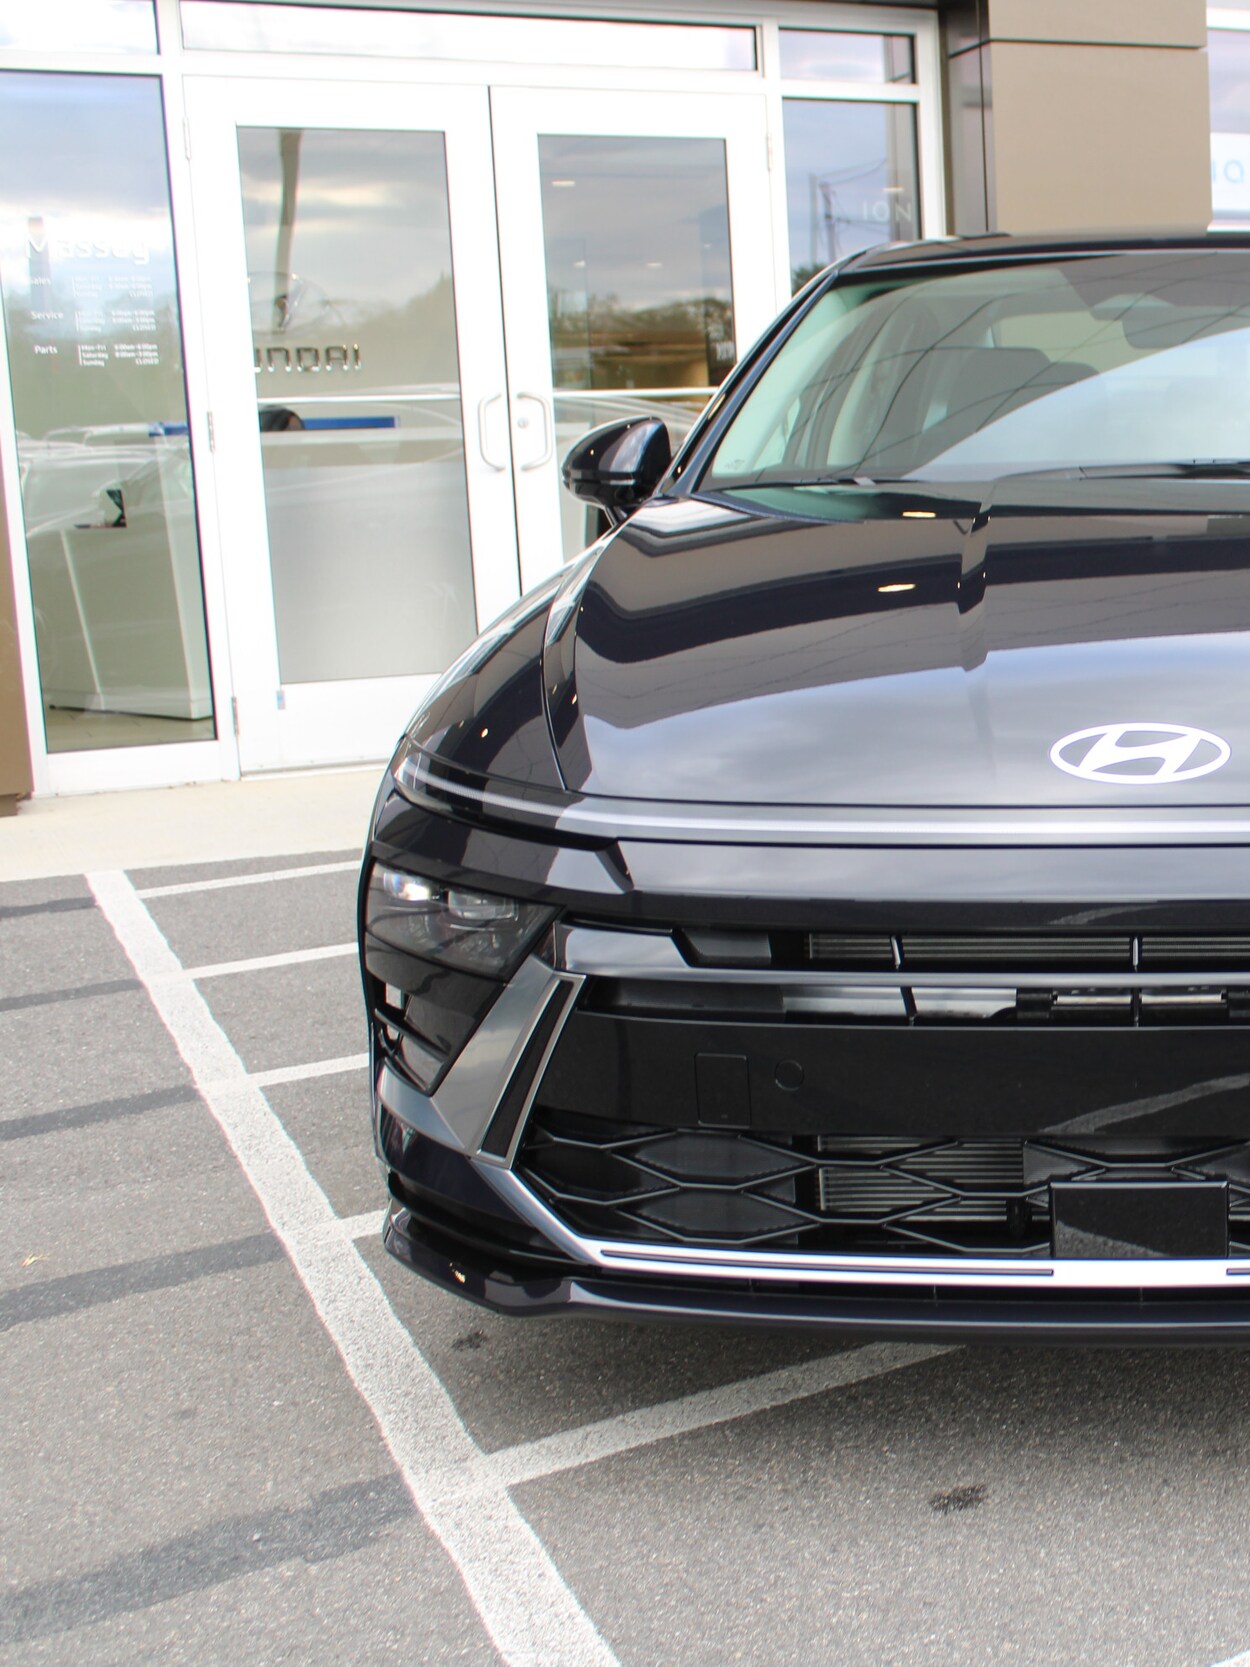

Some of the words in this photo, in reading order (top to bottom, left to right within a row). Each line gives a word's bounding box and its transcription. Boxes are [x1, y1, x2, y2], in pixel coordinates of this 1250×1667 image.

[29, 276, 51, 287] ales
[31, 311, 64, 320] Service
[34, 345, 58, 355] Parts
